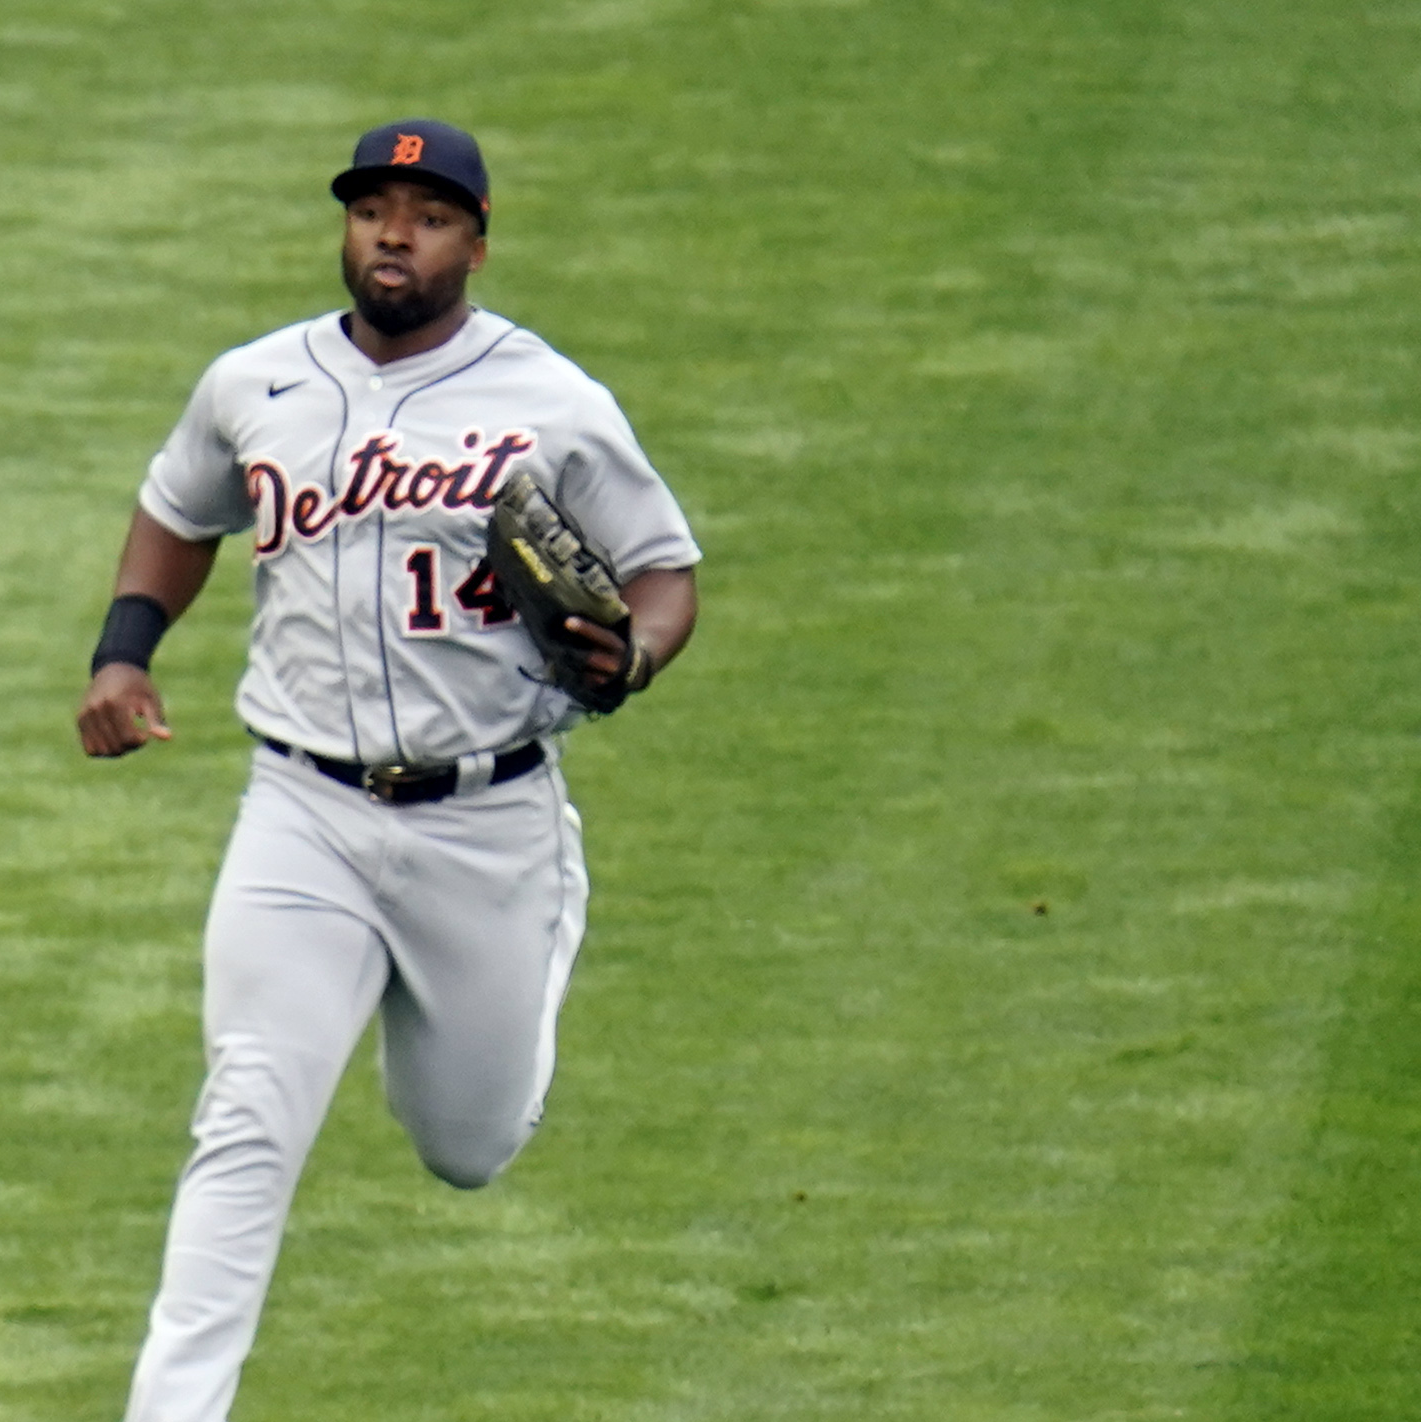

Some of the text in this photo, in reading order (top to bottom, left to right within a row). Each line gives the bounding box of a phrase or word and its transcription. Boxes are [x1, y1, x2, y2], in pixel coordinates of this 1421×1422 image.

[390, 133, 424, 165] D
[247, 432, 536, 556] Detroit
[405, 545, 517, 632] 14
